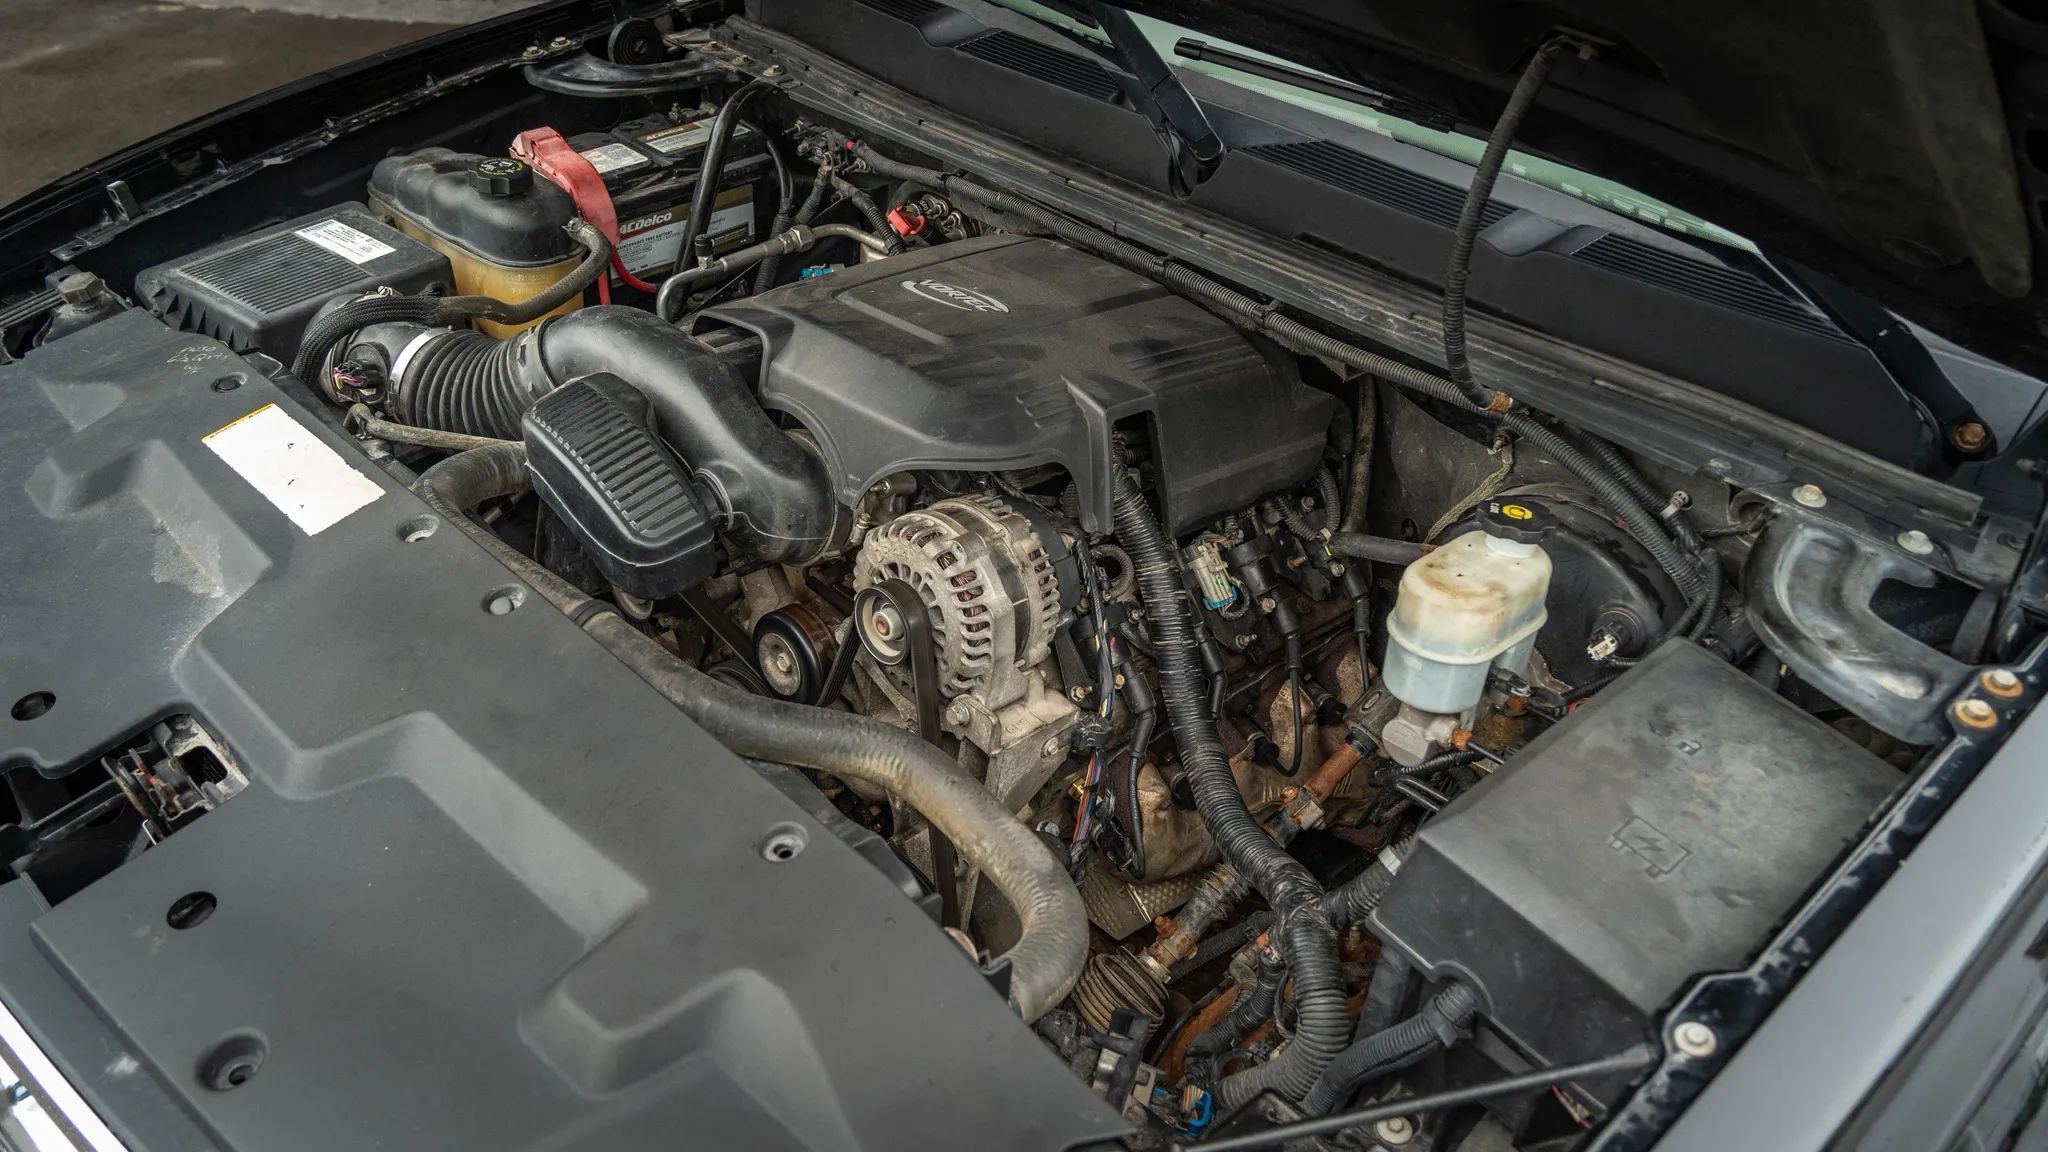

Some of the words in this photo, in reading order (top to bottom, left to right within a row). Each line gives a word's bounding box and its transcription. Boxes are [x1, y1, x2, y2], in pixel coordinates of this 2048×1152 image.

[646, 127, 684, 141] ACDelco
[619, 211, 673, 234] ACDelco
[919, 279, 1003, 312] VORTEC
